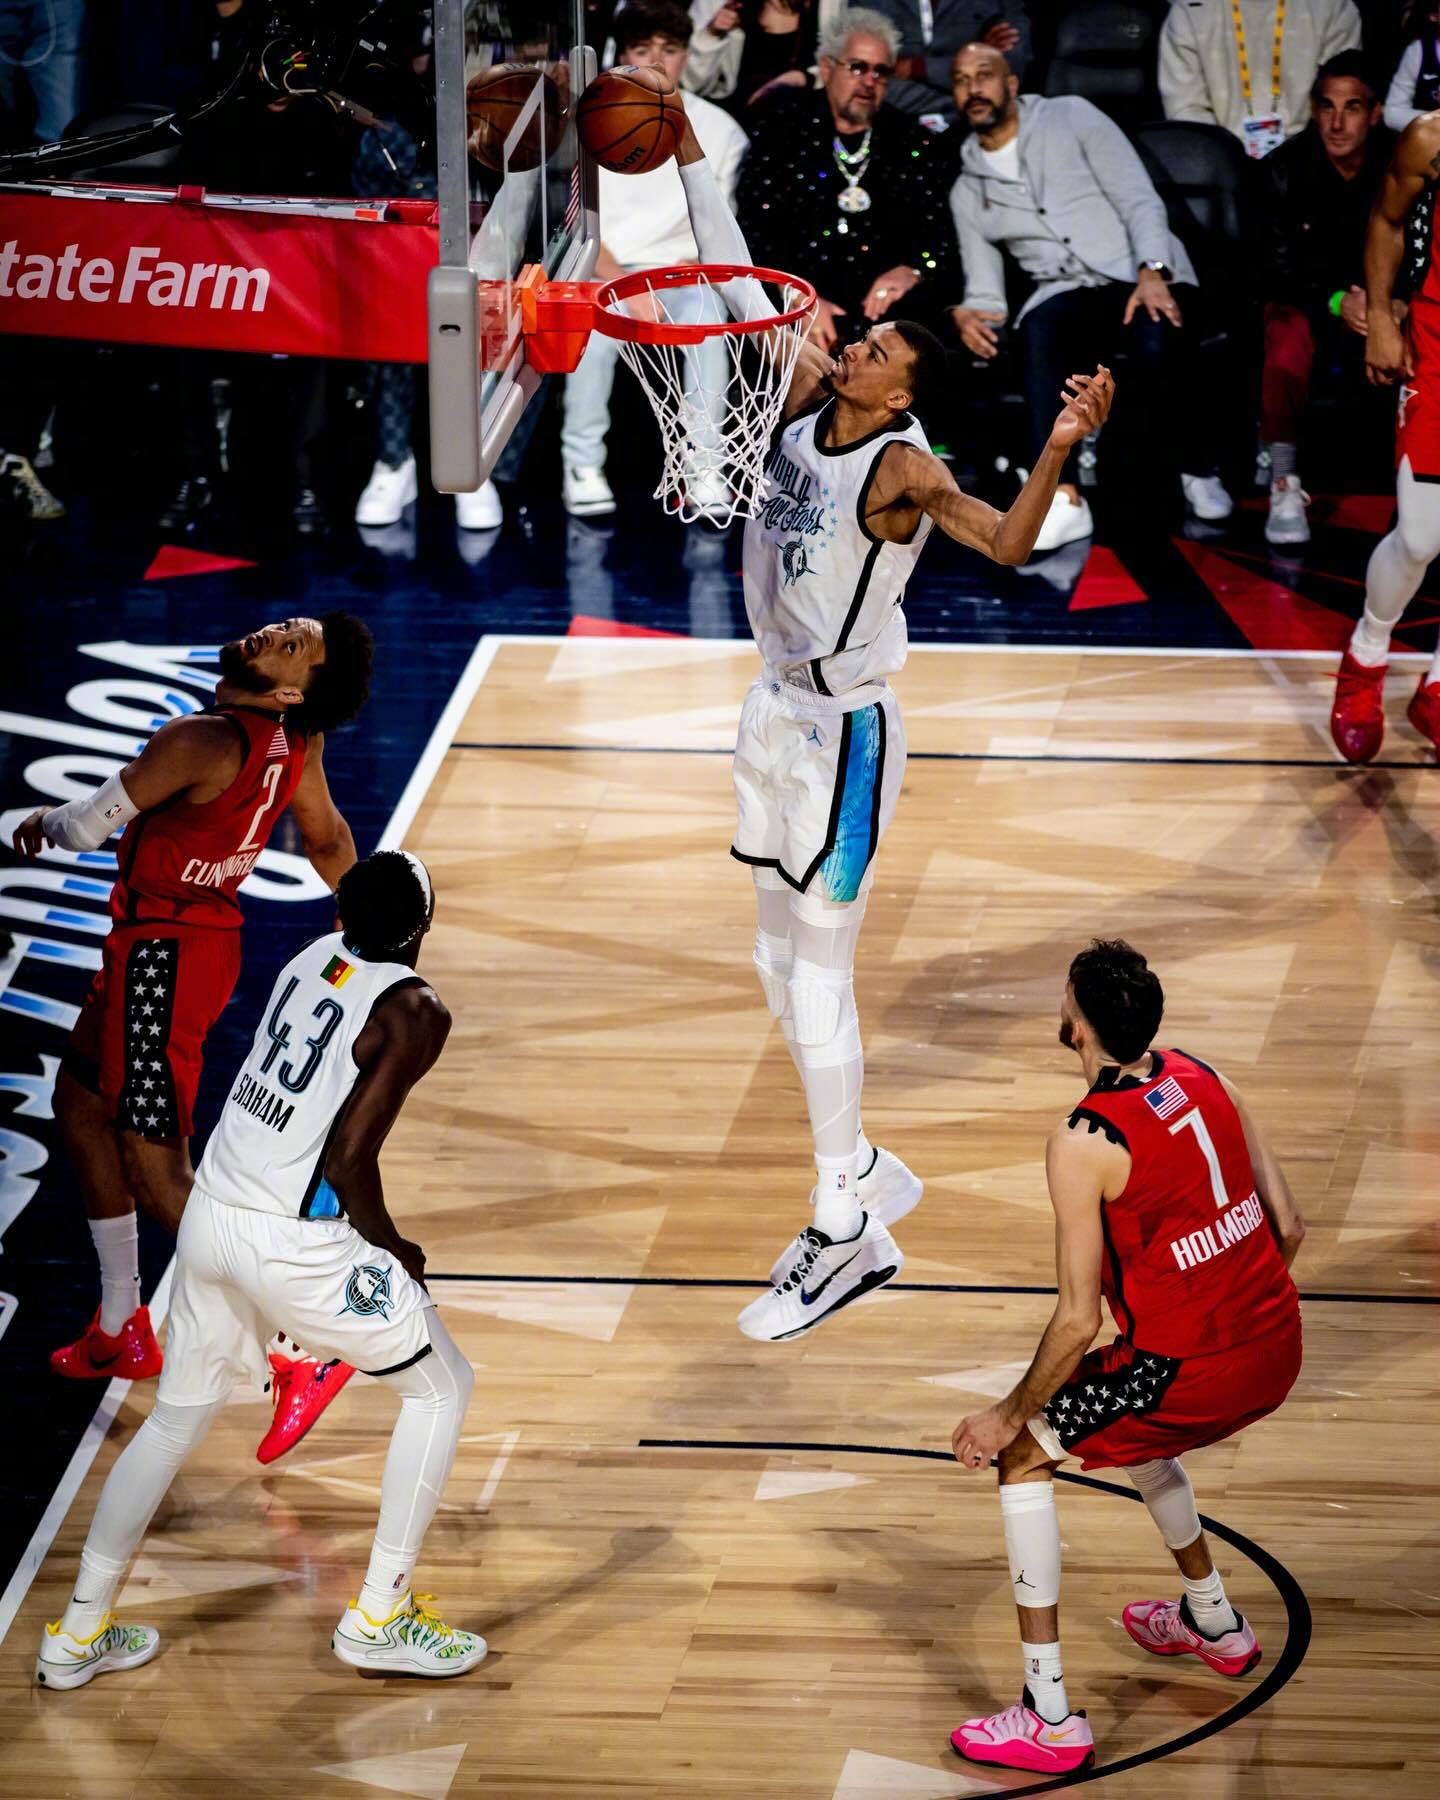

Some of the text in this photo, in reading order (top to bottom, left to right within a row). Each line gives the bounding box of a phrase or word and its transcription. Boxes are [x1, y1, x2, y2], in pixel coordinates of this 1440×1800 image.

[237, 763, 284, 852] 2
[267, 975, 345, 1095] 43
[231, 1073, 296, 1134] SIAKAM
[1167, 1106, 1230, 1209] 7
